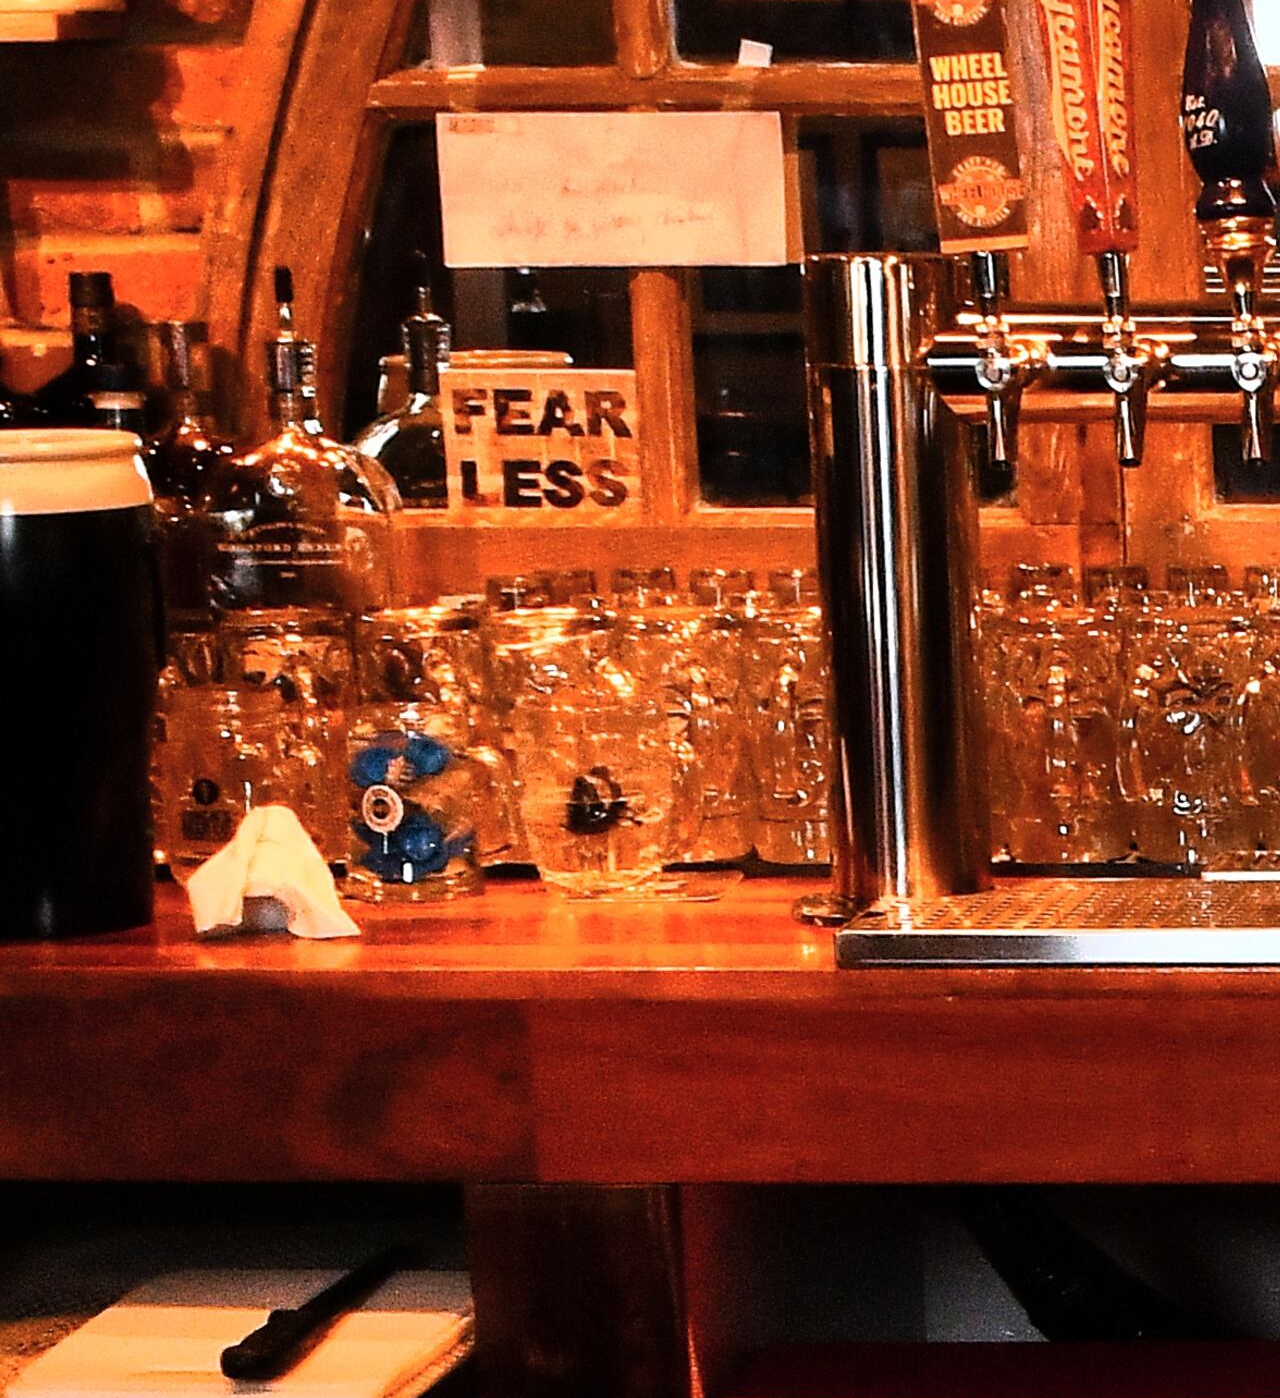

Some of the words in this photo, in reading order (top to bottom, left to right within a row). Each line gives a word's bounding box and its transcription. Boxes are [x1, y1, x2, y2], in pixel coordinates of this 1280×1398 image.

[929, 52, 1008, 81] WHEEL
[931, 79, 1013, 110] HOUSE
[945, 107, 1006, 136] BEER
[452, 387, 632, 438] FEAR
[460, 458, 630, 508] LESS
